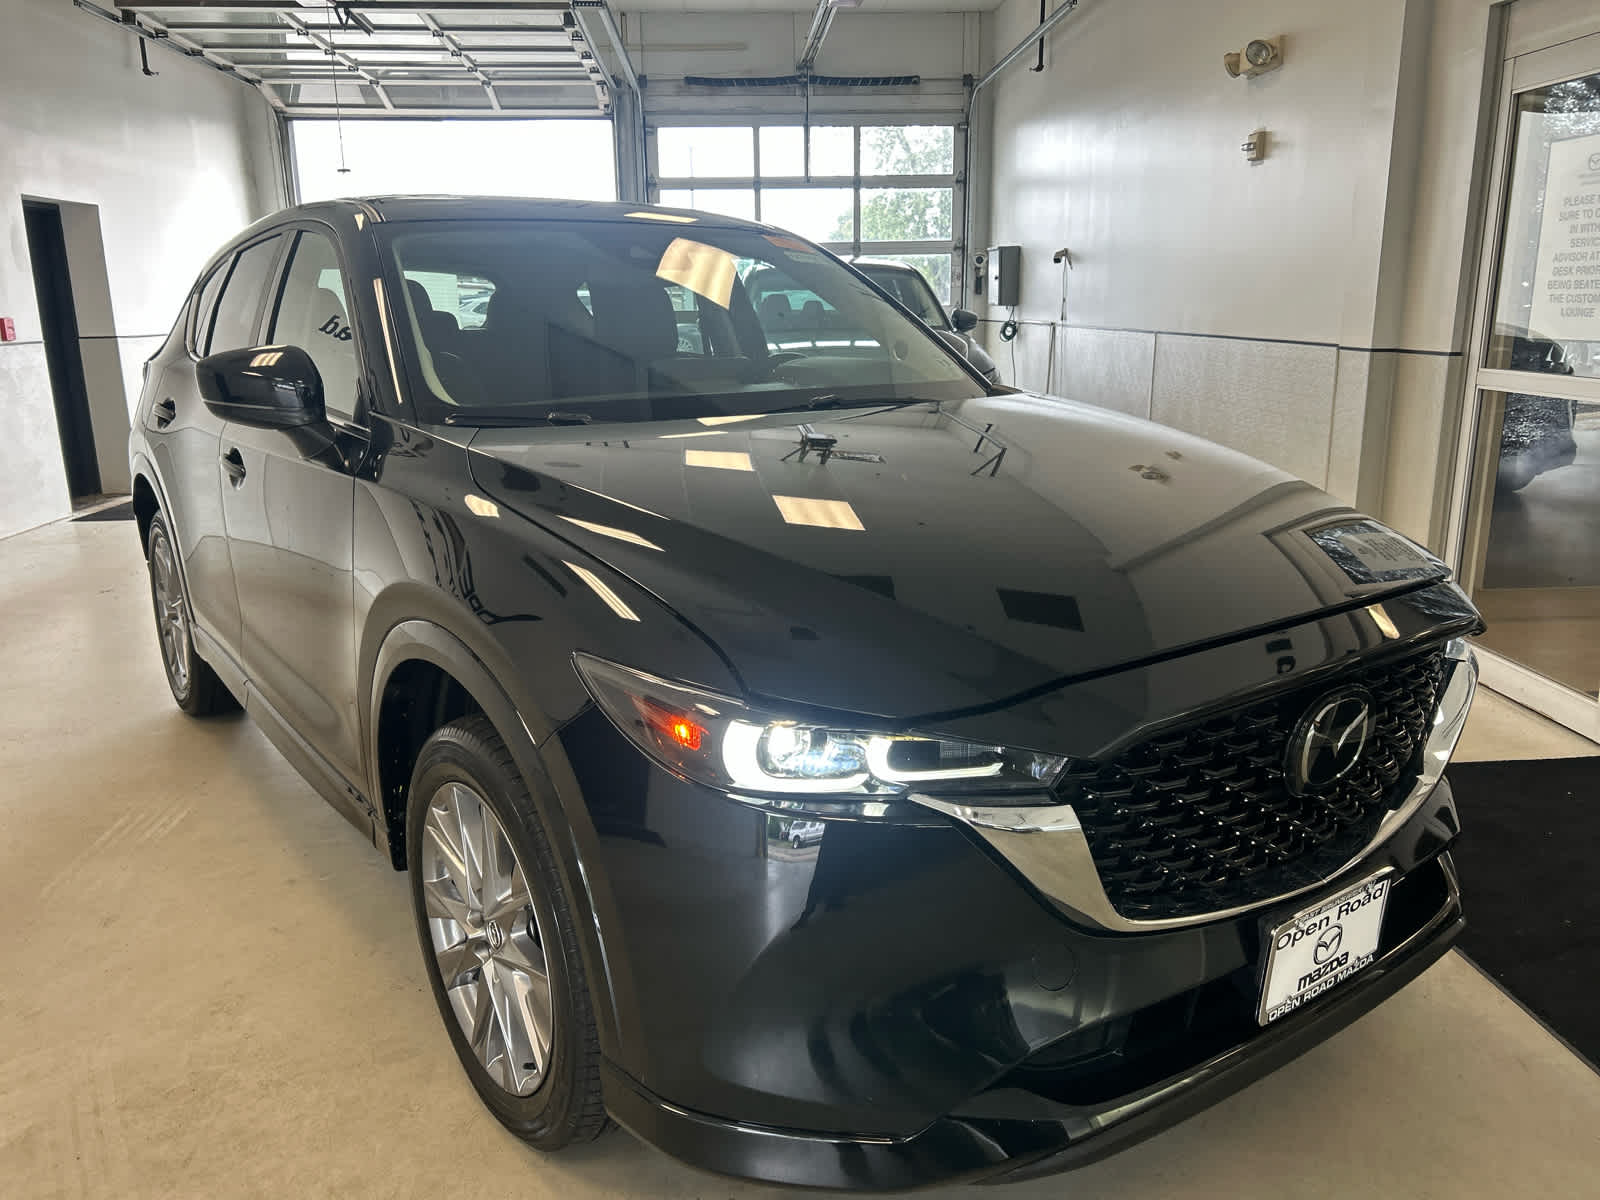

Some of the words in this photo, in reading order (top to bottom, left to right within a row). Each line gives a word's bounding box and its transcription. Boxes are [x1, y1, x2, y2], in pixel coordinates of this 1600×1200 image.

[1563, 194, 1596, 207] PLEASE
[1559, 209, 1581, 222] SURE
[1582, 208, 1595, 219] TO
[1552, 250, 1588, 263] ADVISOR
[1552, 265, 1574, 277] DESK
[1547, 280, 1572, 290] BEING
[1549, 293, 1565, 304] THE
[1560, 306, 1596, 318] LOUNGE
[1276, 915, 1330, 951] Open
[1336, 882, 1385, 921] Road
[1268, 996, 1301, 1022] OPEN
[1303, 977, 1335, 1003] ROAD
[1337, 954, 1374, 983] MAZDA
